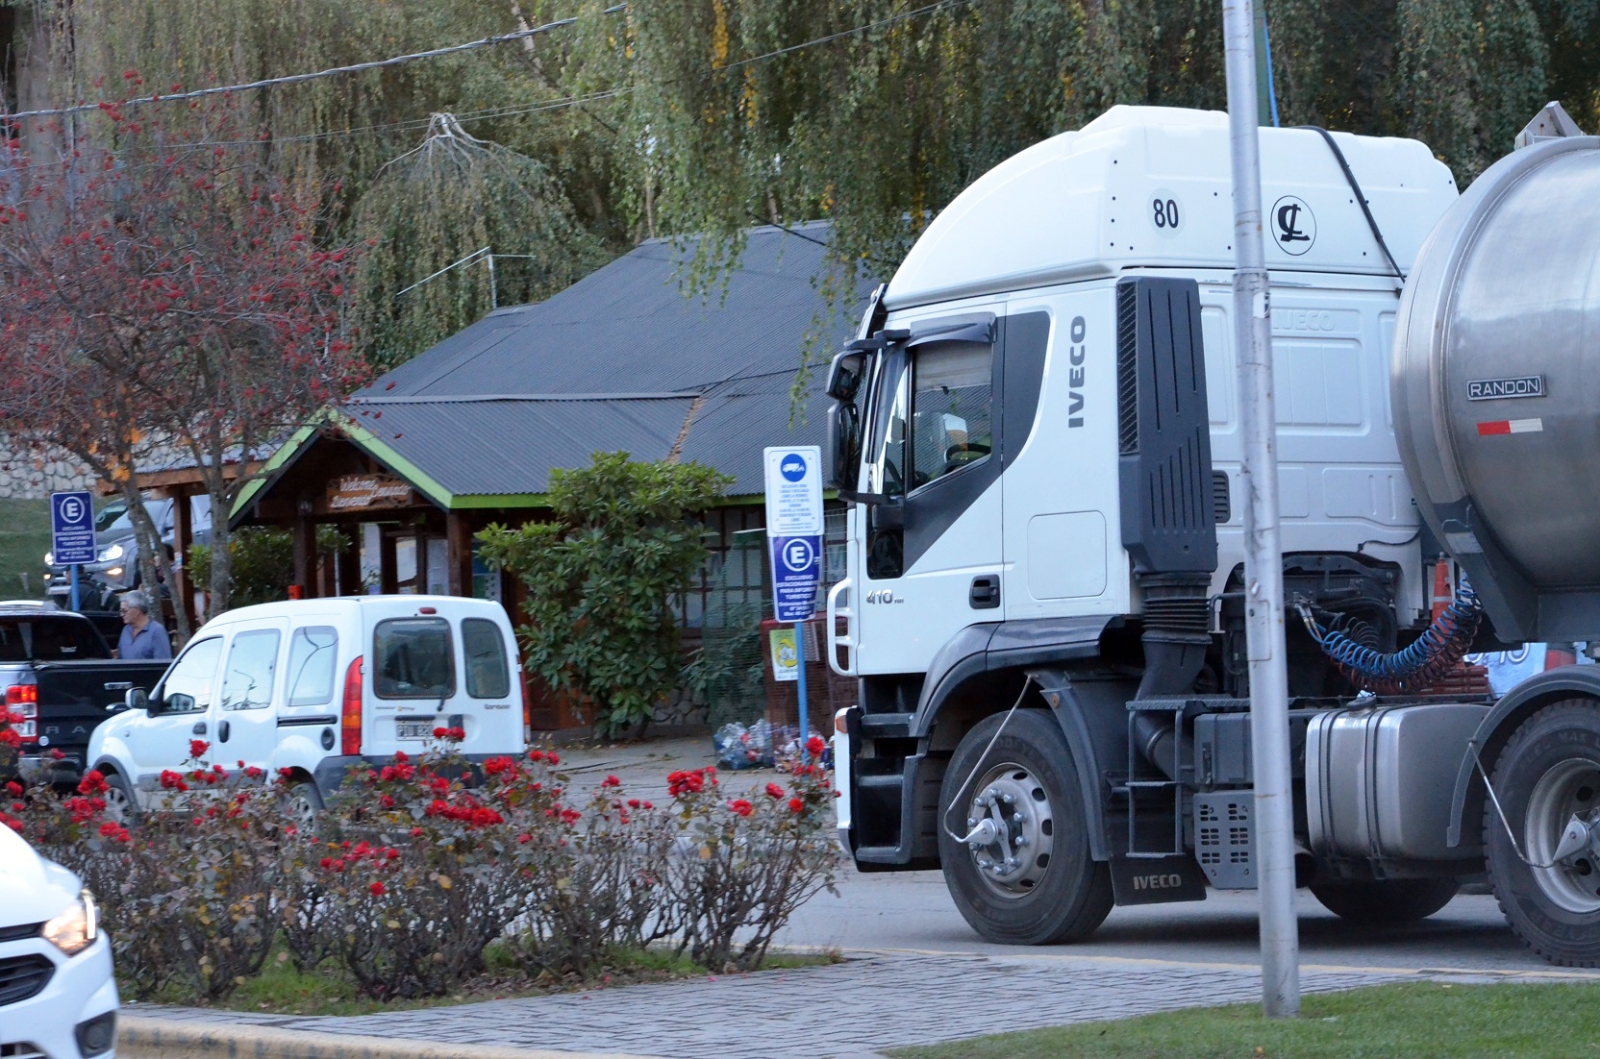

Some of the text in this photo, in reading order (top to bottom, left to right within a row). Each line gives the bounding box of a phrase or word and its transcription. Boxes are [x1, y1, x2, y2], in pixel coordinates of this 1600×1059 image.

[1152, 198, 1179, 229] 80
[1068, 315, 1086, 428] IVECO
[1470, 379, 1539, 397] RANDON
[66, 502, 79, 517] E
[790, 546, 806, 564] E
[866, 588, 893, 605] 410
[1133, 873, 1182, 890] IVECO
